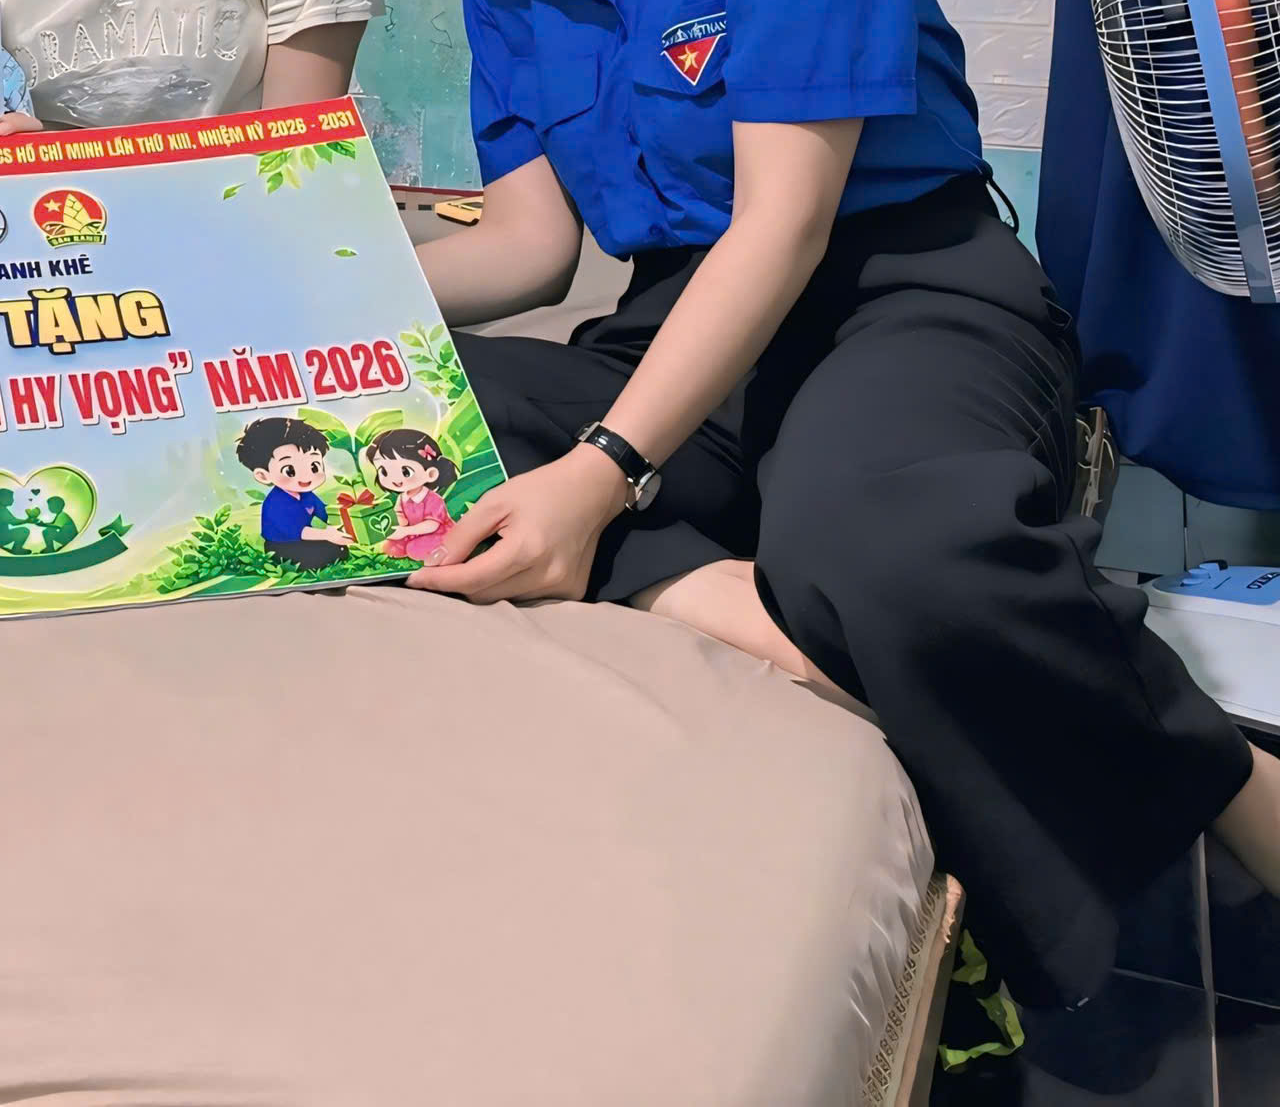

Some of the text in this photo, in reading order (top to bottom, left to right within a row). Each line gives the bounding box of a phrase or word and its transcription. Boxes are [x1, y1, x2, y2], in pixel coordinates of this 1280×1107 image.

[66, 140, 104, 159] MINH
[167, 132, 197, 151] XIII,
[197, 124, 245, 148] NHIỆM
[267, 118, 307, 138] 2026
[318, 110, 355, 131] 2031
[50, 253, 94, 276] KHÊ
[9, 375, 57, 425] HY
[204, 347, 303, 408] NĂM
[305, 340, 405, 396] 2026
